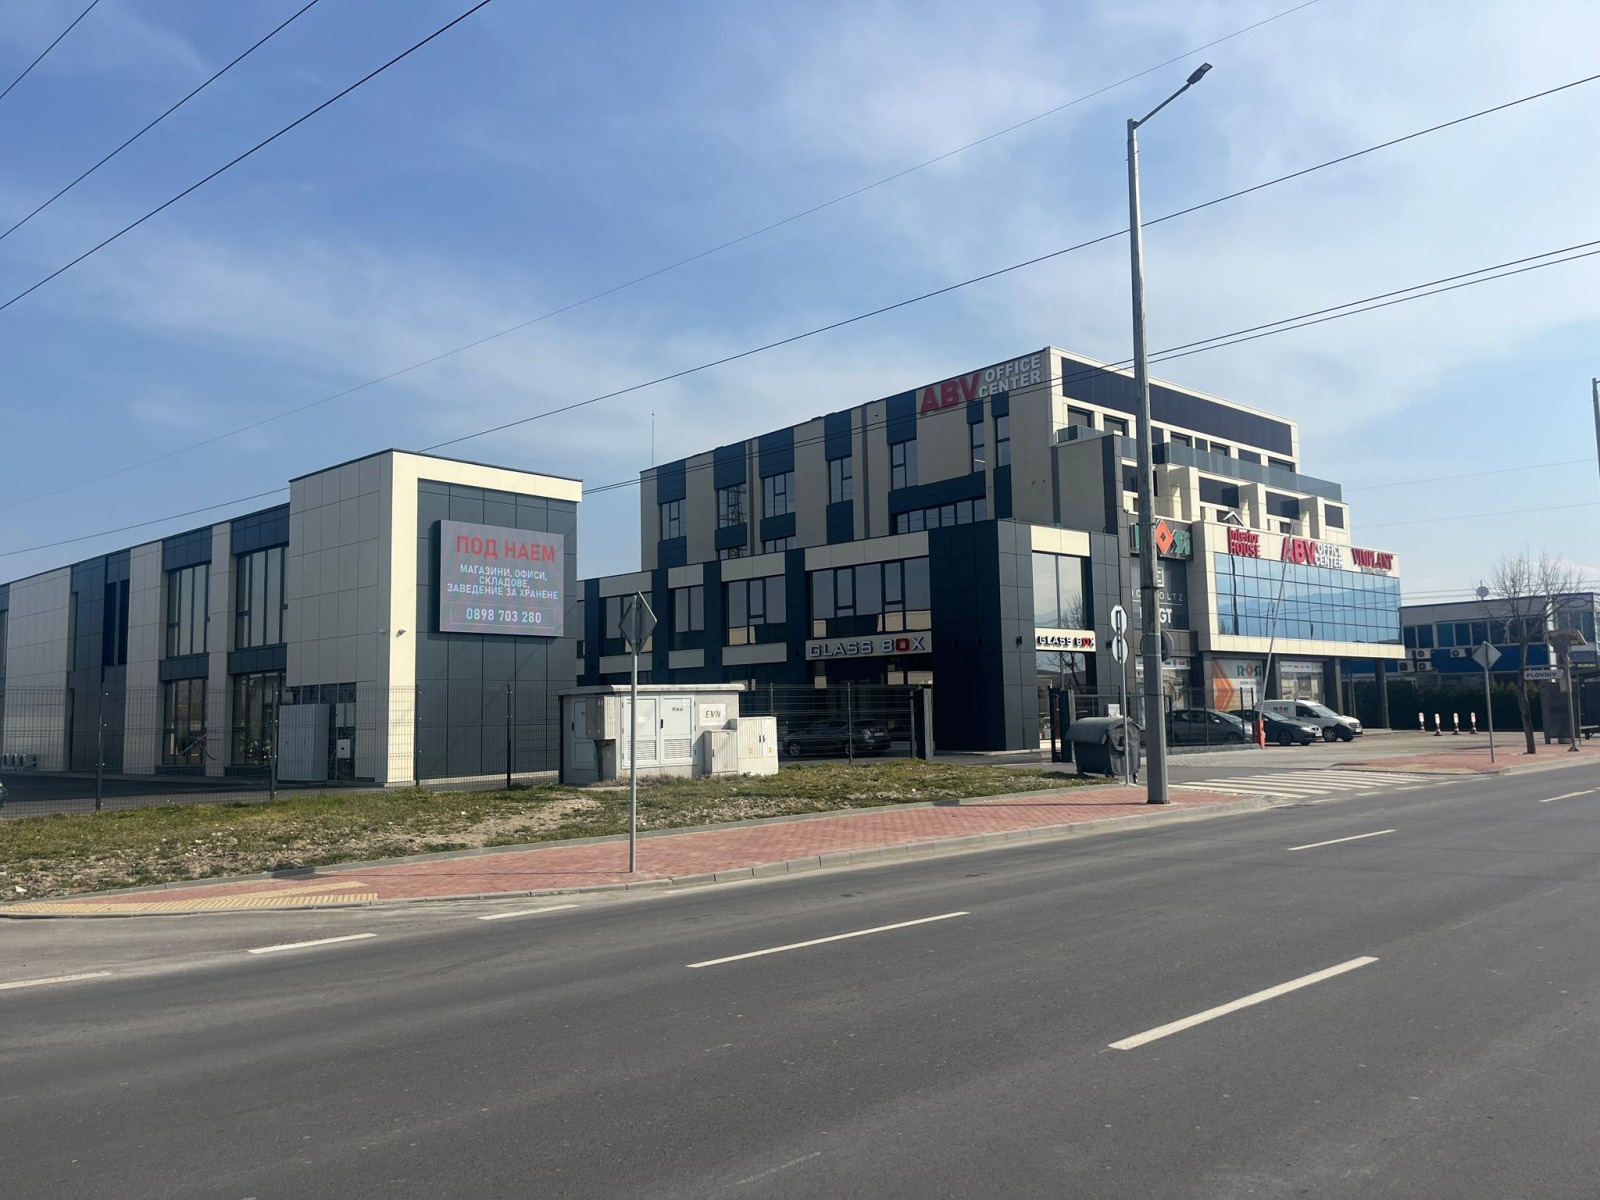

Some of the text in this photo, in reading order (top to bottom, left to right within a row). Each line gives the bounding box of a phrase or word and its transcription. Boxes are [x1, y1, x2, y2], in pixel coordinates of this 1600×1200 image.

[983, 354, 1041, 383] OFFICE
[978, 369, 1041, 398] CENTER
[919, 372, 981, 416] ABV
[456, 535, 556, 562] ПОД НАЕМ
[1229, 540, 1261, 558] HOUSE
[1281, 537, 1317, 565] ABV
[1317, 543, 1343, 558] OFFICE
[1315, 553, 1343, 568] CENTER
[460, 564, 548, 581] МАГАЗИНИ, ОФИСИ,
[479, 576, 530, 589] СКЛАДОВЕ,
[447, 583, 559, 600] ЗАВЕДЕНИЕ ЗА ХРАНЕНЕ
[466, 607, 542, 624] 0898 703 280
[809, 637, 925, 658] GLASS BOX
[1038, 636, 1095, 648] GLASS BOX
[705, 710, 721, 719] EVN
